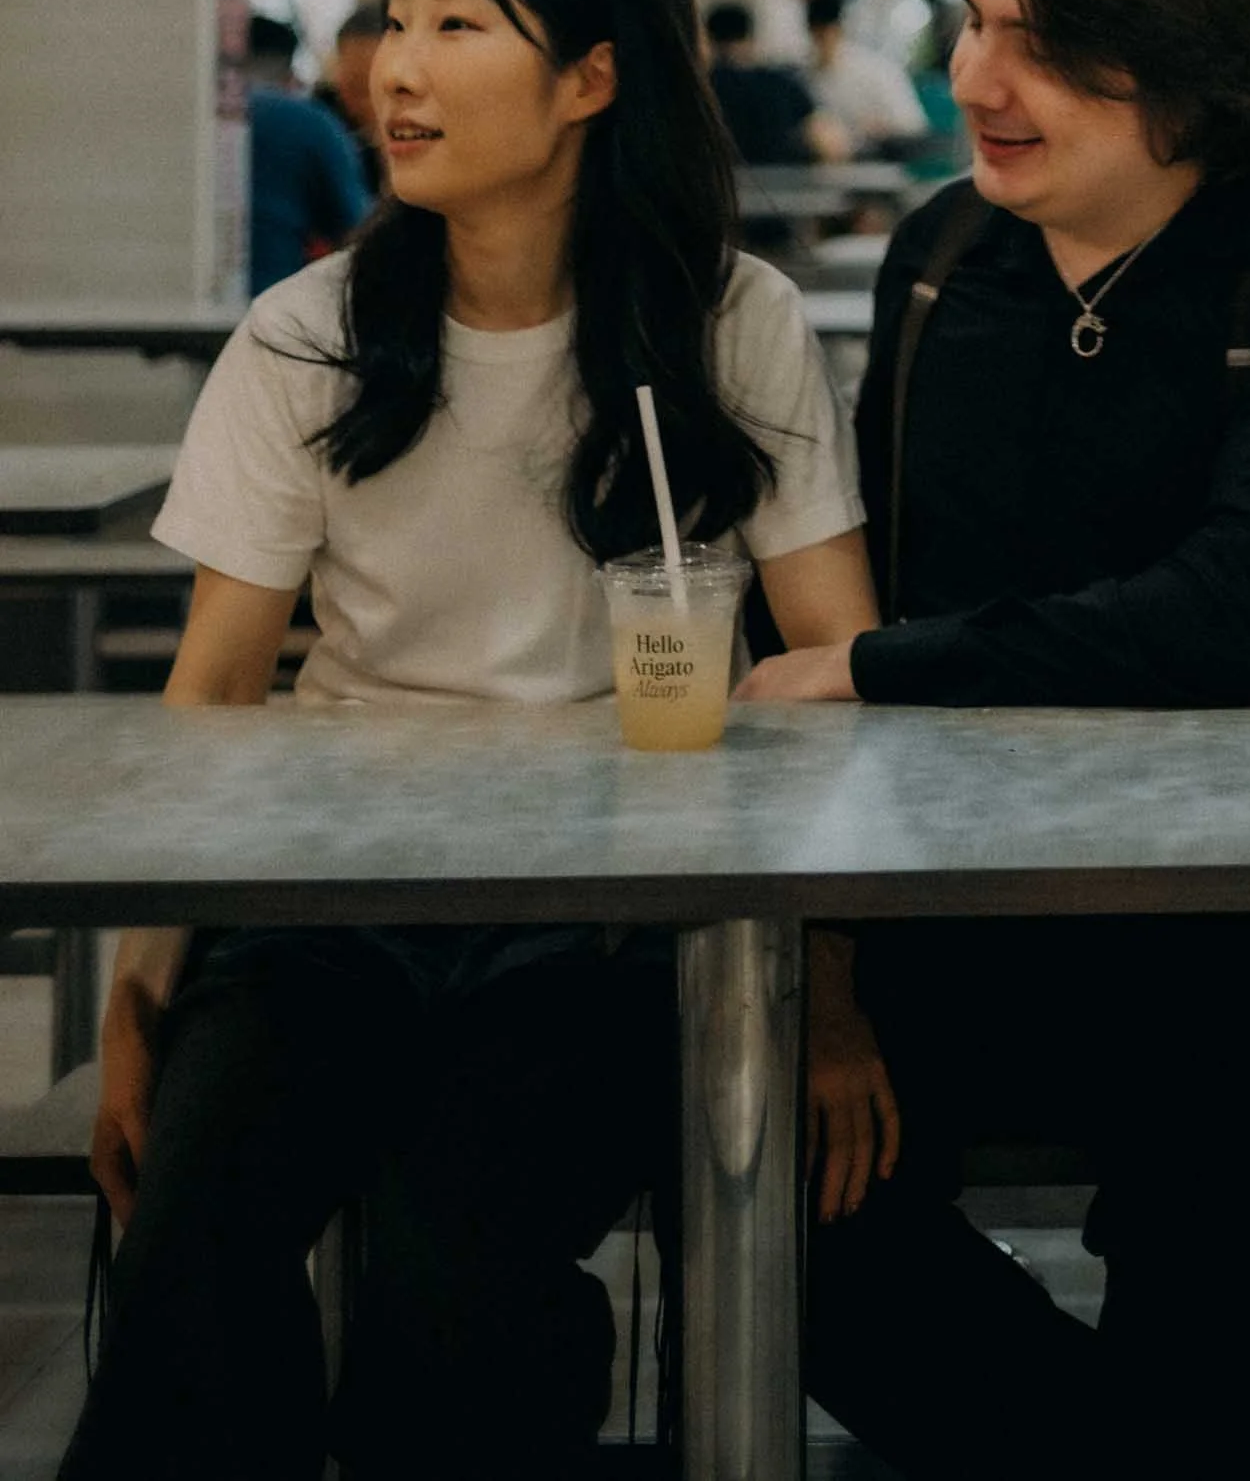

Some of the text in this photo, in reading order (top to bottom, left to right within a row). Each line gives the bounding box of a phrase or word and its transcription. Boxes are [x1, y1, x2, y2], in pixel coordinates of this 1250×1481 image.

[637, 634, 684, 654] Hello
[631, 657, 694, 681] Arigato
[633, 680, 690, 703] Always
